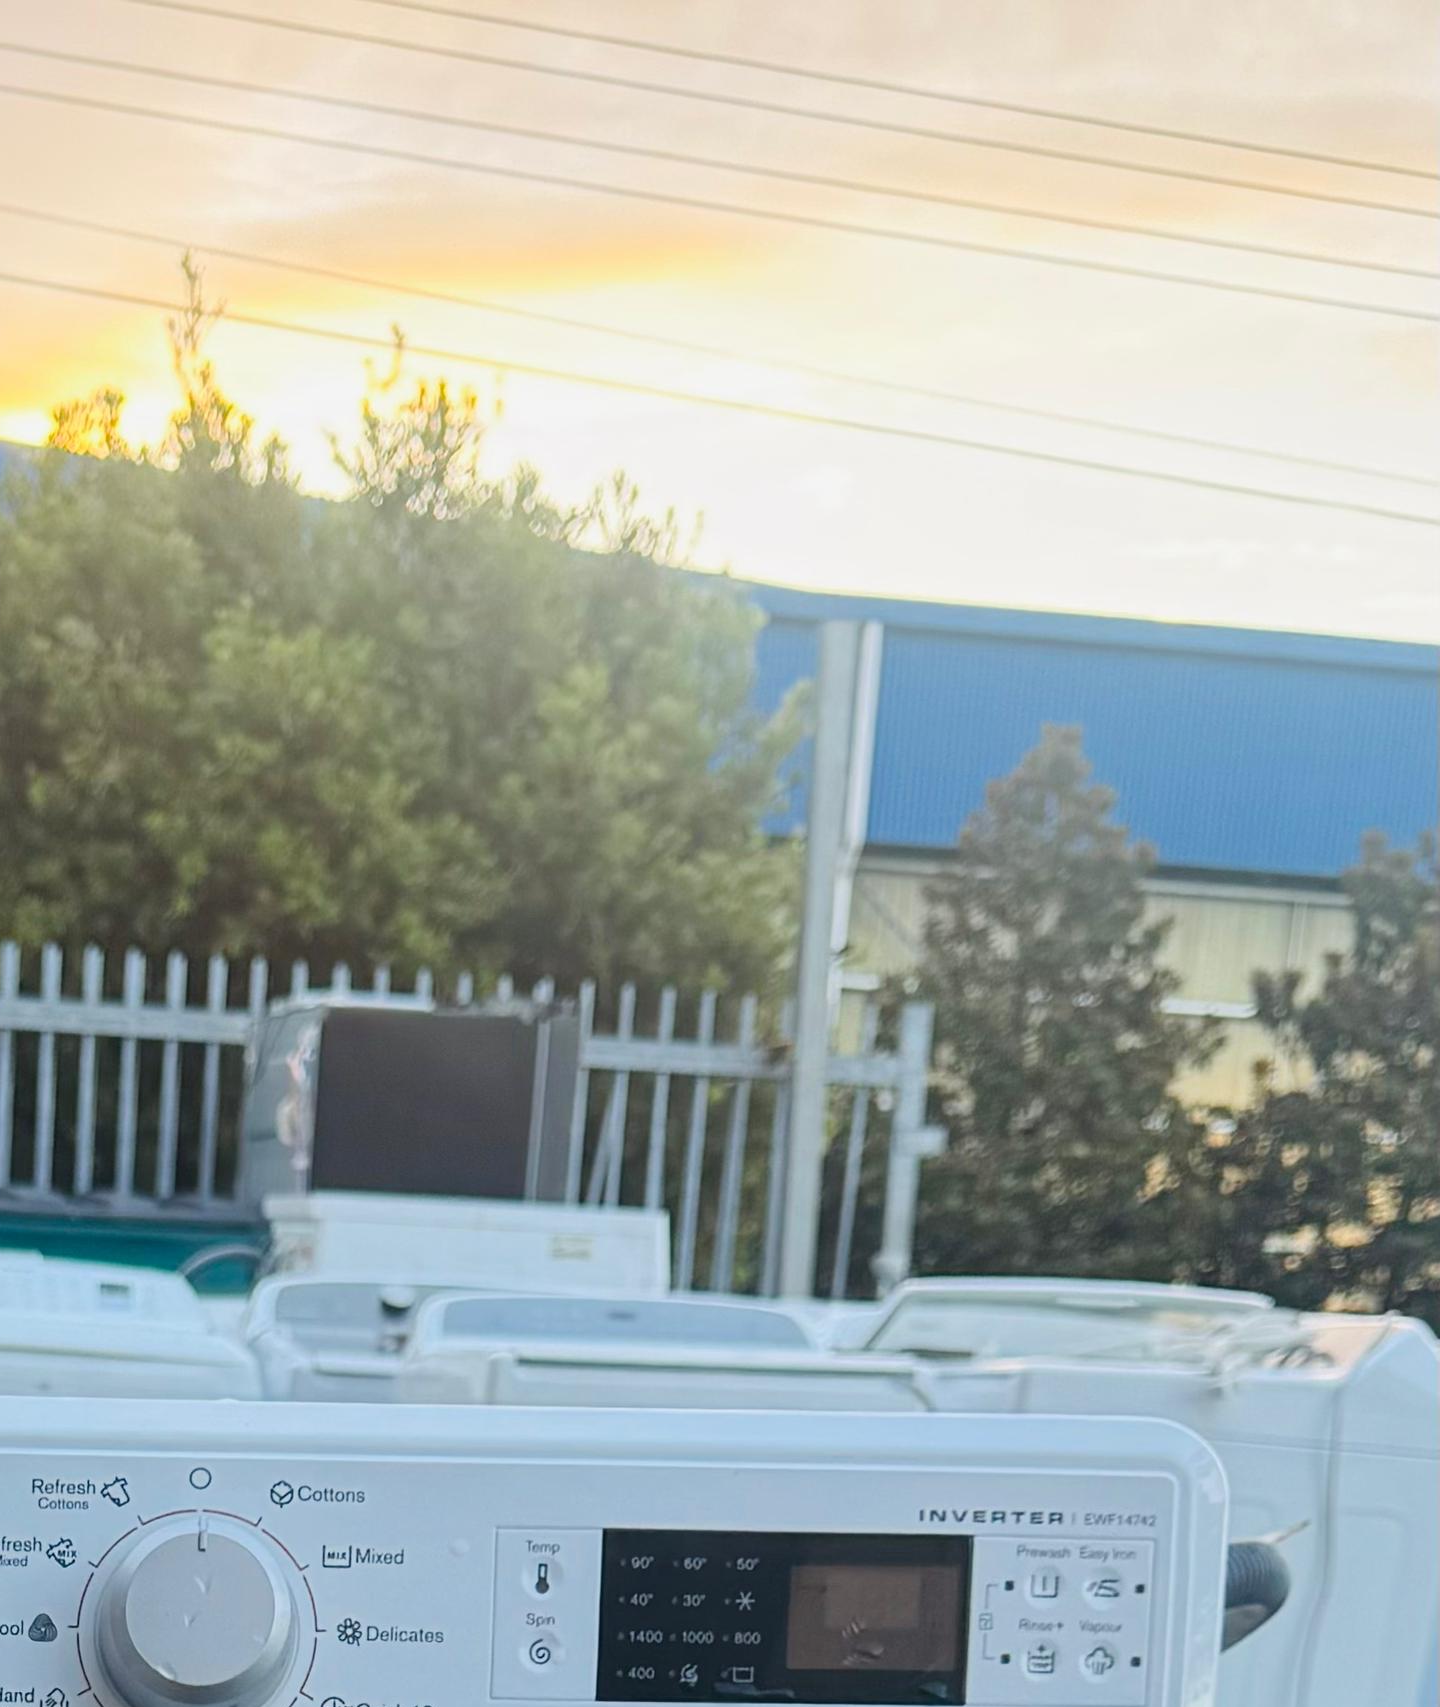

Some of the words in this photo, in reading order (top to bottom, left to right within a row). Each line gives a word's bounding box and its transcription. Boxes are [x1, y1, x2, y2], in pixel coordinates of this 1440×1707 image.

[32, 1479, 95, 1494] Refresh
[298, 1485, 365, 1503] Cottons
[38, 1497, 89, 1510] Cottons
[920, 1510, 1063, 1524] INVERTER
[1083, 1513, 1157, 1527] EWF14742
[526, 1540, 560, 1555] Temp
[1017, 1545, 1071, 1558] Prewash
[1079, 1546, 1108, 1562] Easy
[1112, 1548, 1136, 1560] Iron
[356, 1548, 404, 1564] Mixed
[526, 1613, 555, 1627] Spin
[1079, 1619, 1123, 1633] Vapour
[367, 1626, 444, 1643] Delicates
[629, 1630, 663, 1643] 1400
[682, 1631, 714, 1644] 1000
[734, 1632, 760, 1644] 800
[628, 1667, 655, 1679] 400
